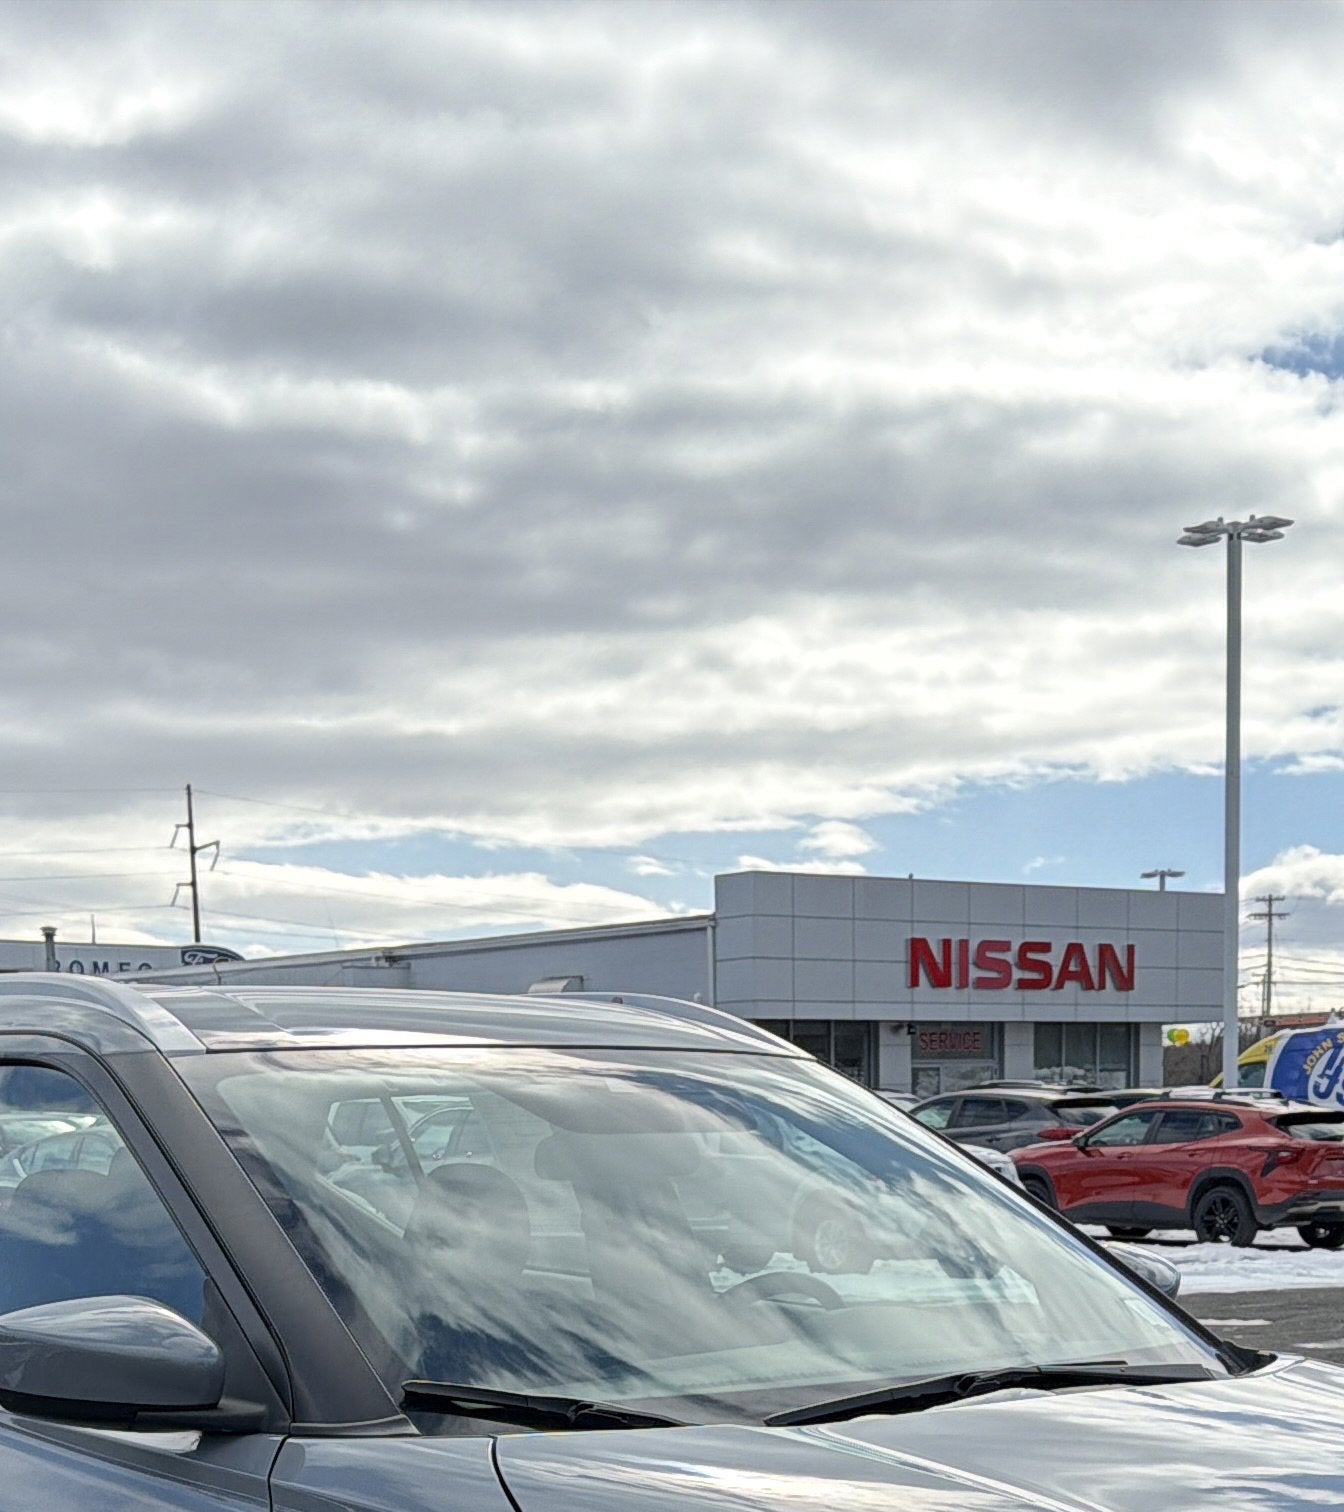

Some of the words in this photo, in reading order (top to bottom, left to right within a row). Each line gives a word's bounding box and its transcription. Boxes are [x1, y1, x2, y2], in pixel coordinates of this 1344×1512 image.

[908, 937, 1136, 992] NISSAN
[919, 1030, 982, 1051] SERVICE
[1302, 1038, 1334, 1075] JOHN
